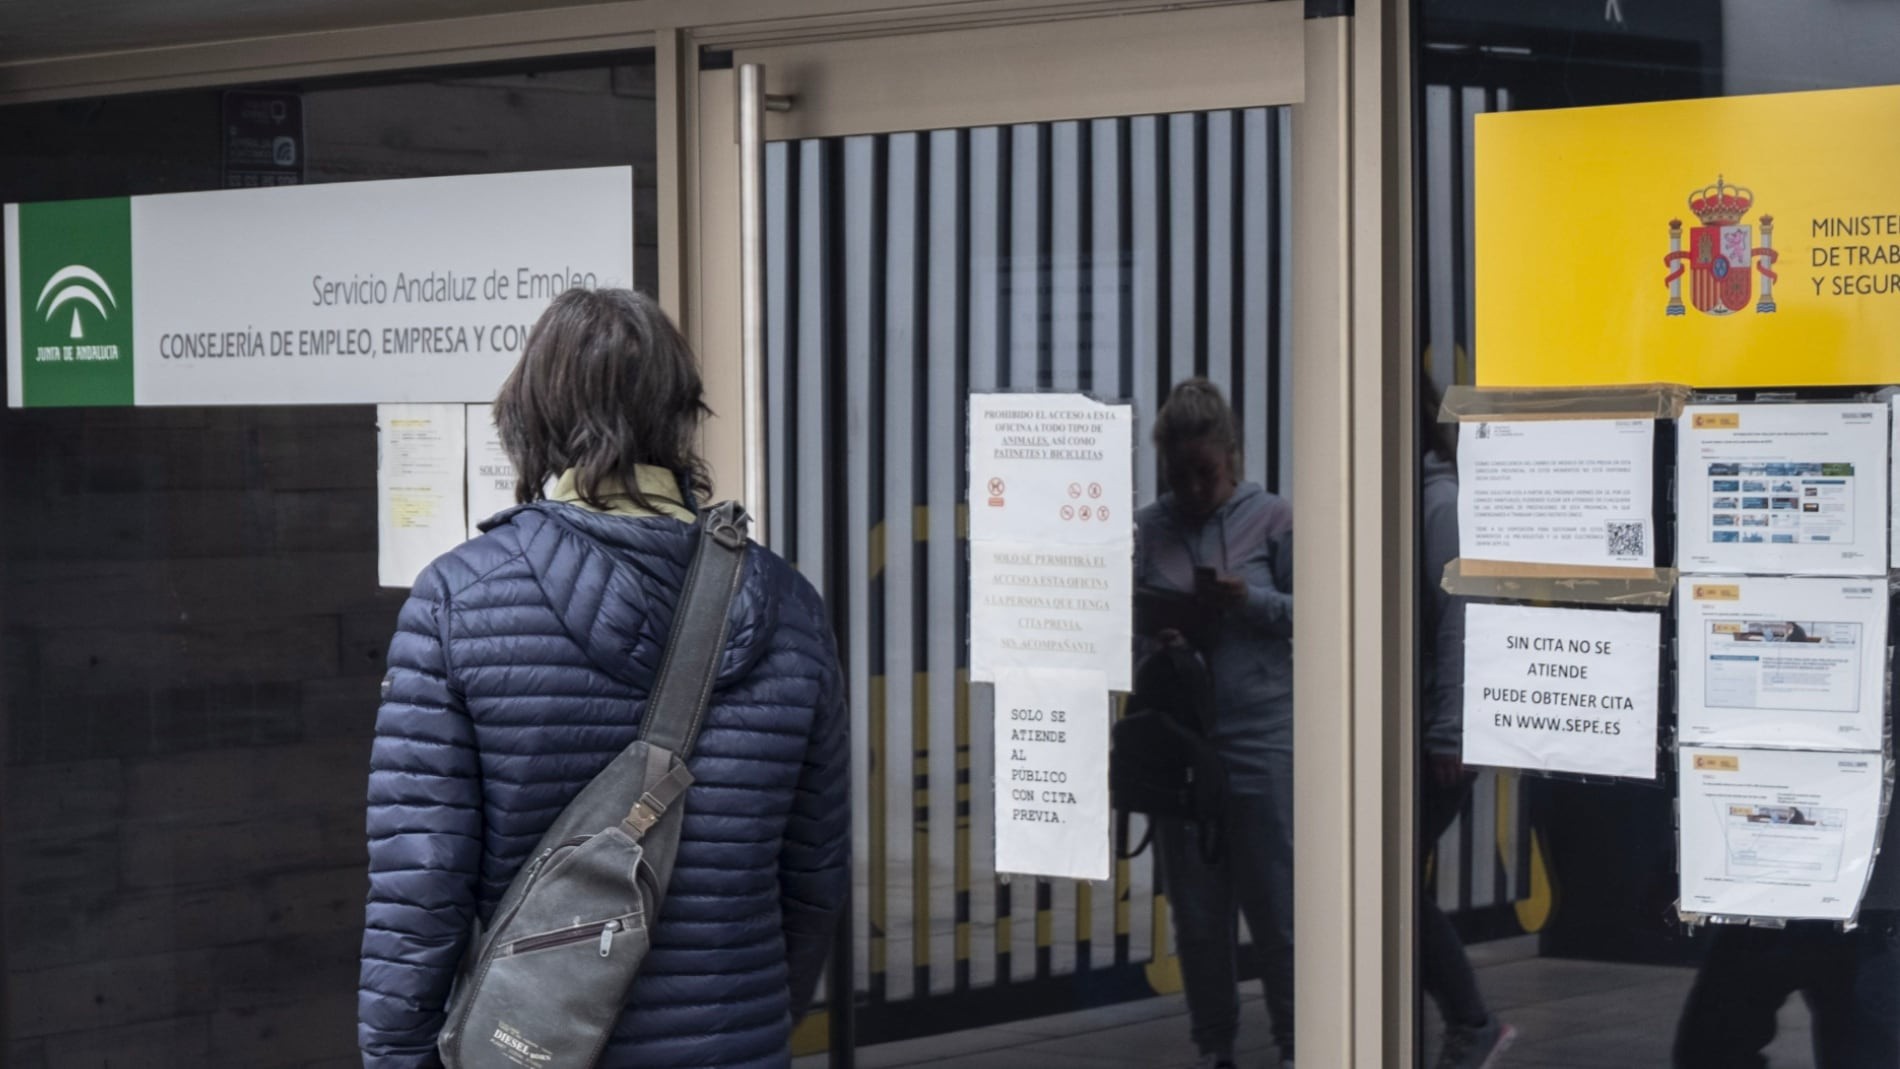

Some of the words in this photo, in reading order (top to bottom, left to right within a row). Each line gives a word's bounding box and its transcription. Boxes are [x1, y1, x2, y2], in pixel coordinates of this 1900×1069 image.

[1812, 215, 1900, 238] MINISTE
[1812, 247, 1840, 267] DE
[1844, 244, 1900, 265] TRAB
[312, 273, 387, 306] Servicio
[393, 271, 476, 303] Andaluz
[483, 269, 509, 301] de
[1811, 276, 1825, 296] Y
[1832, 273, 1900, 296] SEGUR
[159, 324, 265, 359] CONSEJERÍA
[270, 330, 294, 357] DE
[298, 328, 377, 358] EMPLEO,
[382, 326, 469, 354] EMPRESA
[473, 325, 486, 352] Y
[36, 346, 61, 361] JUNTA
[62, 346, 74, 361] DE
[984, 410, 1034, 420] PROHIBIDO
[1035, 411, 1047, 420] EL
[1048, 411, 1084, 421] ACCESO
[1085, 412, 1092, 421] A
[1093, 411, 1116, 421] ESTA
[995, 423, 1032, 433] OFICINA
[1041, 424, 1066, 433] TODO
[1067, 424, 1089, 433] TIPO
[1090, 424, 1103, 433] DE
[1067, 437, 1096, 446] COMO
[994, 449, 1041, 459] PATINETES
[1050, 450, 1104, 460] BICICLETAS
[1077, 599, 1111, 611] TENGA
[1506, 635, 1529, 651] SIN
[1533, 637, 1564, 652] CITA
[1568, 639, 1591, 654] NO
[1595, 641, 1612, 655] SE
[1527, 662, 1588, 679] ATIENDE
[1483, 687, 1527, 704] PUEDE
[1531, 690, 1596, 709] OBTENER
[1601, 695, 1634, 711] CITA
[1010, 708, 1043, 721] SOLO
[1050, 710, 1066, 722] SE
[1494, 713, 1512, 728] EN
[1516, 714, 1621, 736] WWW.SEPE.ES
[1011, 729, 1067, 743] ATIENDE
[1010, 748, 1027, 761] AL
[1012, 788, 1034, 801] CON
[1041, 790, 1077, 804] CITA
[1012, 808, 1066, 823] PREVIA.
[494, 1029, 530, 1055] DIESEL
